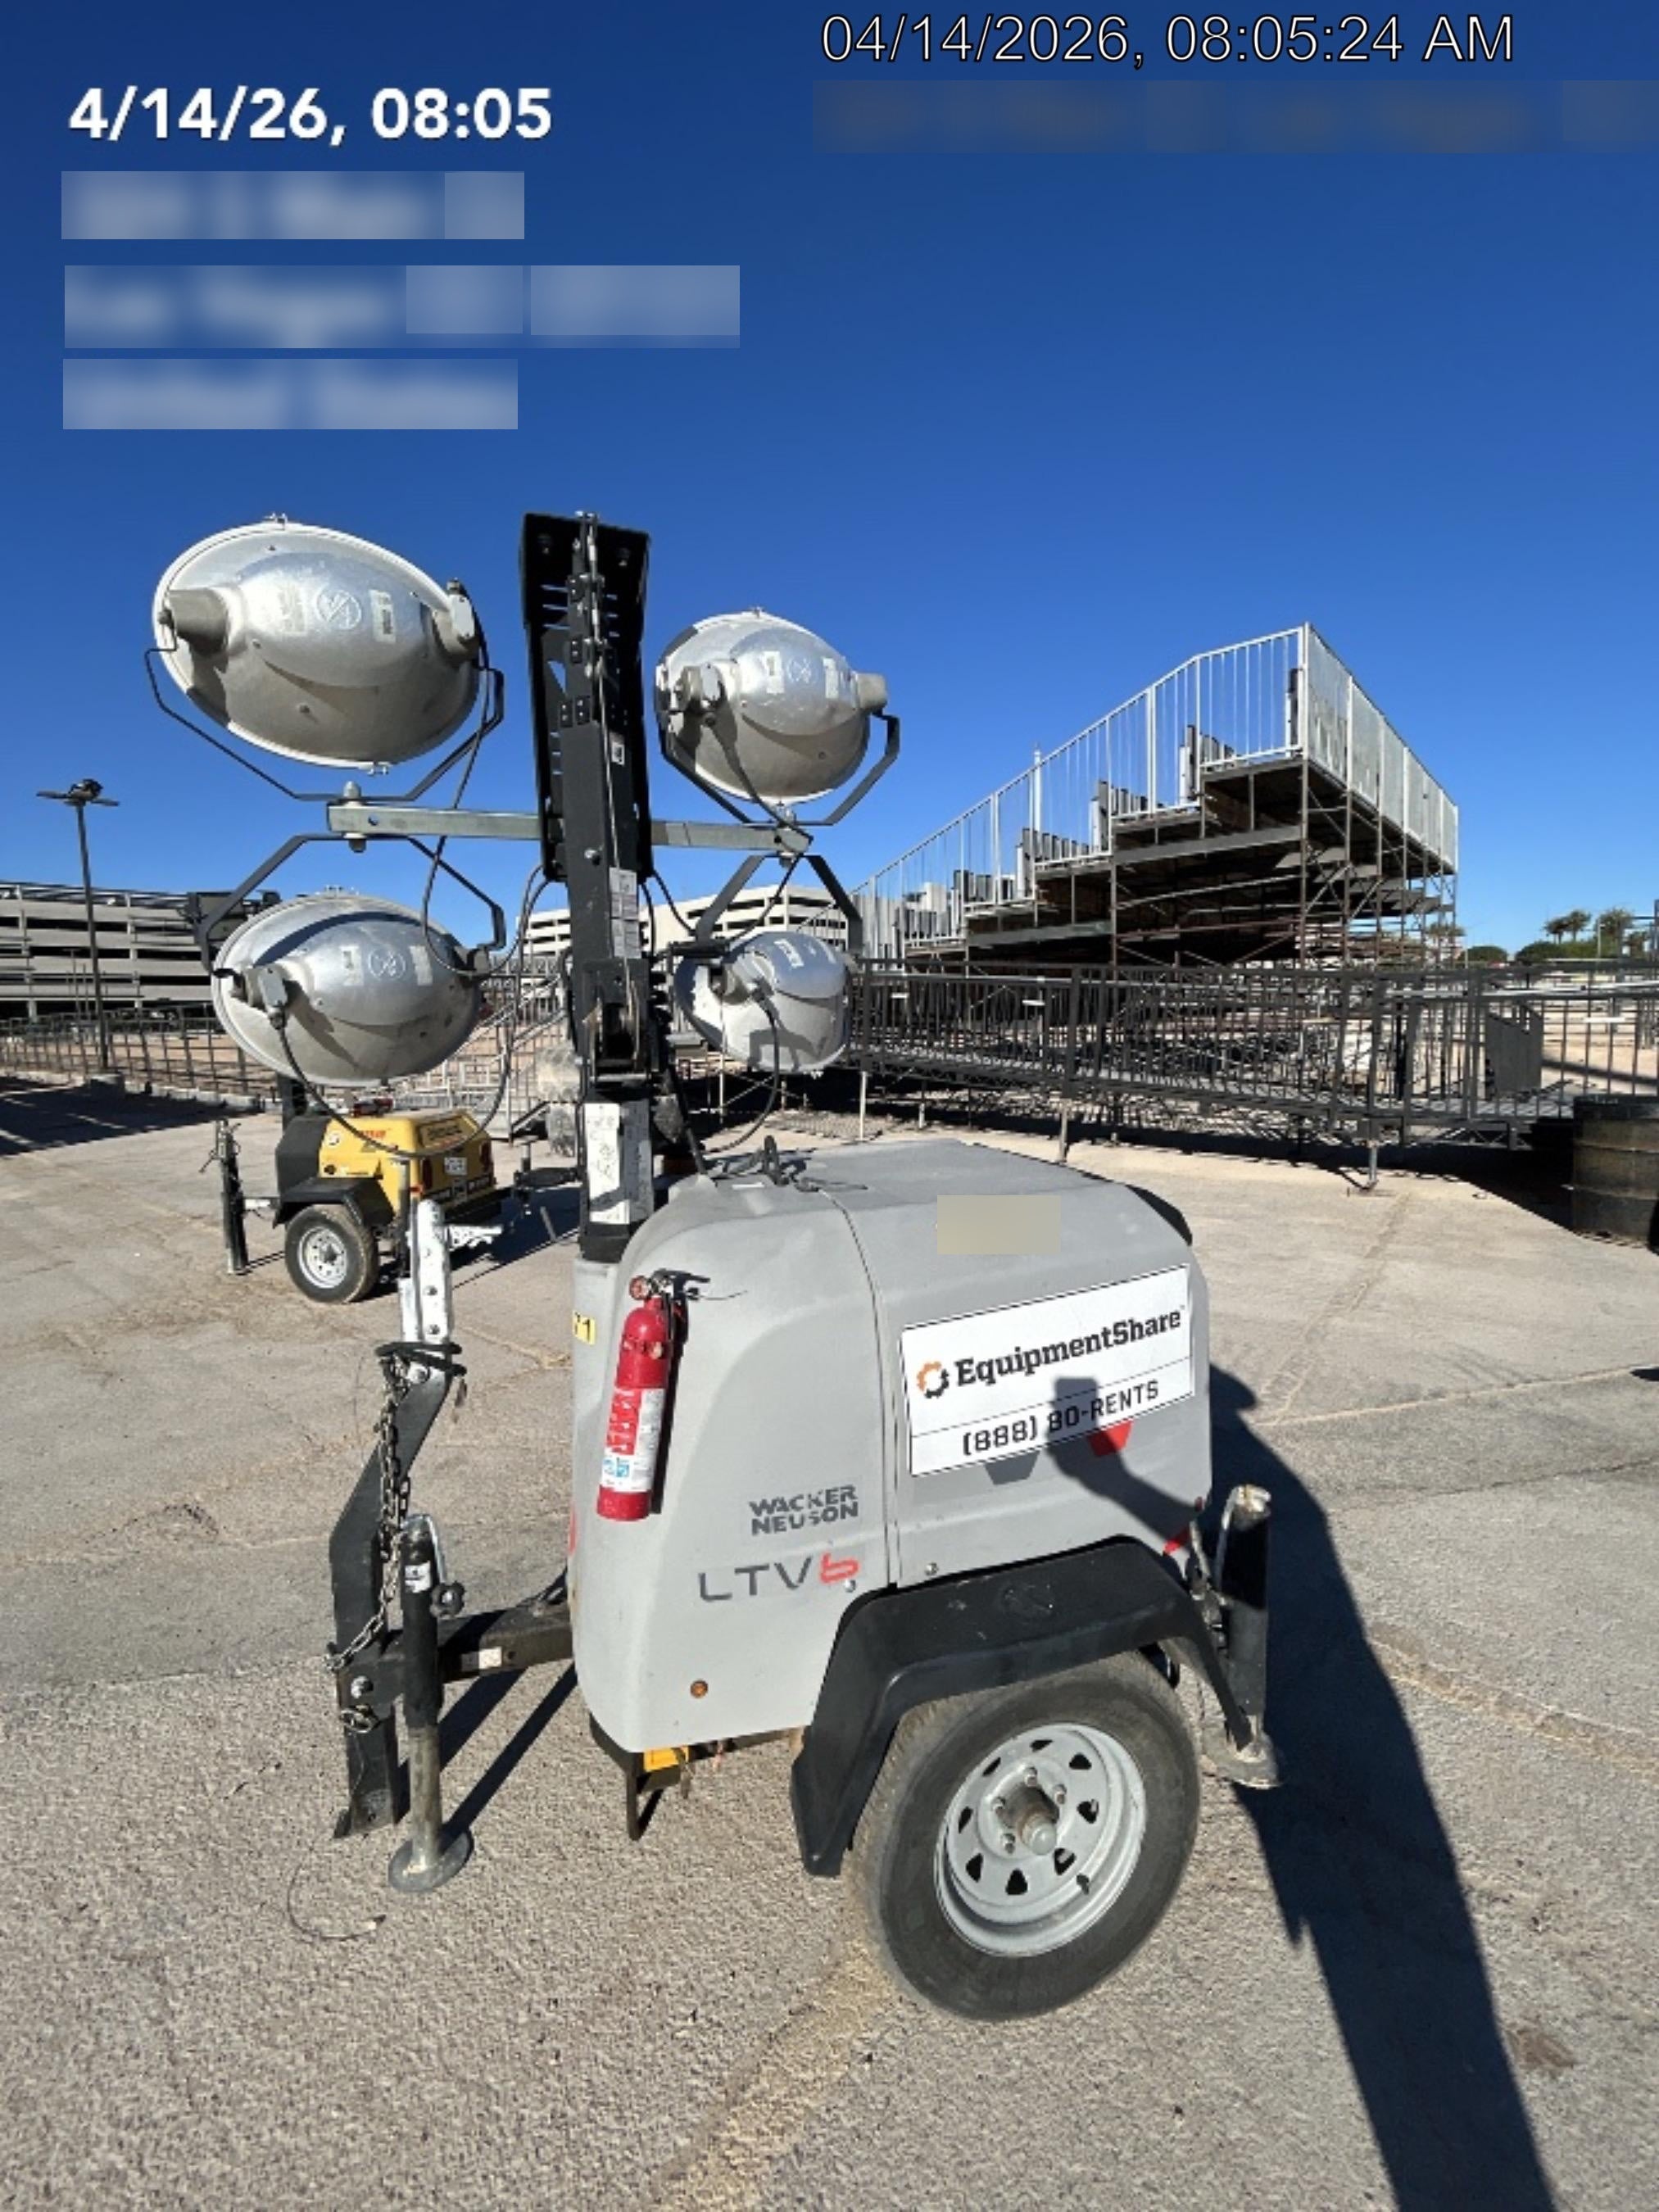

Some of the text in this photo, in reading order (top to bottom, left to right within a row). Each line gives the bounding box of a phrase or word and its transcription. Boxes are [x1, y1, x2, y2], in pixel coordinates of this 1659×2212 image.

[954, 1308, 1181, 1388] EquipmentShare
[963, 1380, 1159, 1456] (888) 80-RENTS
[748, 1484, 859, 1517] WACKER
[751, 1501, 859, 1536] NEUSON
[698, 1552, 860, 1602] LTV6
